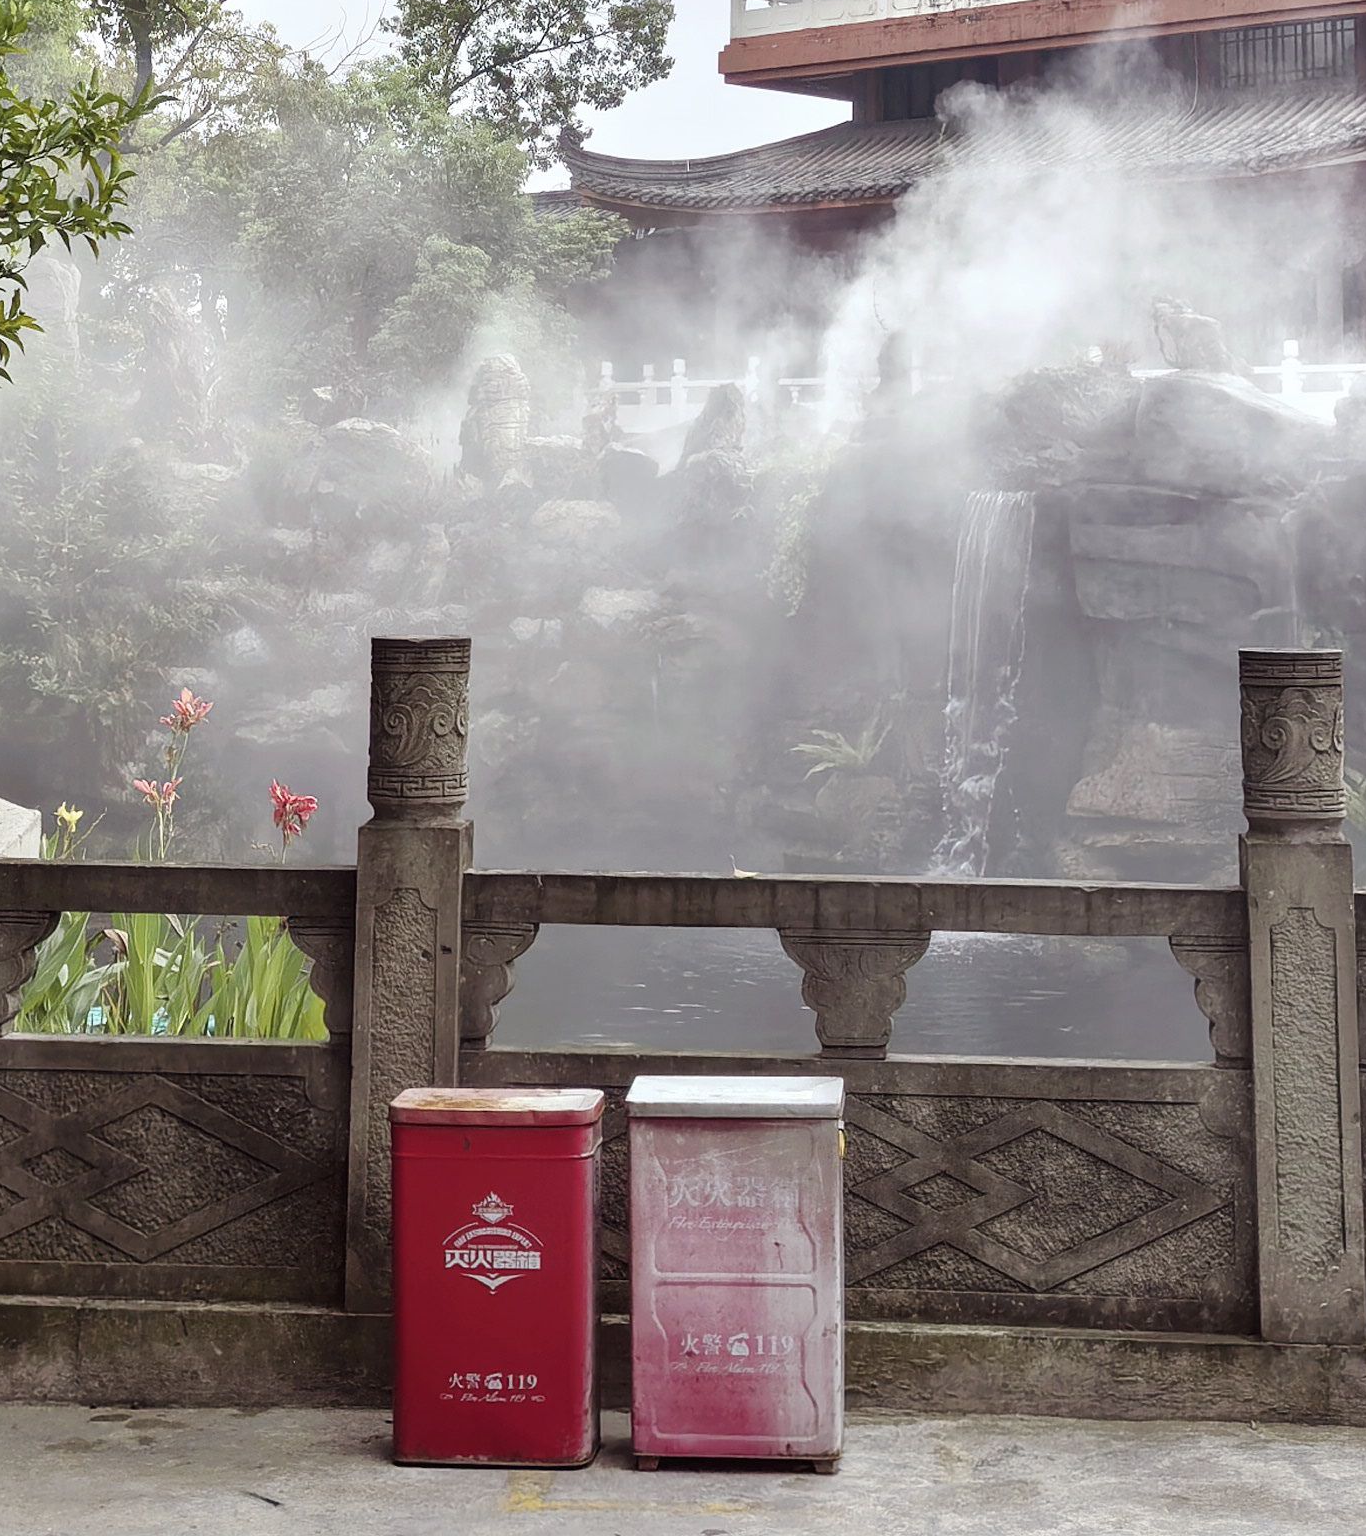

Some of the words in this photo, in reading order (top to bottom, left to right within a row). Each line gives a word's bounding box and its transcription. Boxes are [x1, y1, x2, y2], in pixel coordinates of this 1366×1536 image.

[444, 1249, 541, 1270] 灭火器箱
[679, 1333, 722, 1356] 火警
[754, 1335, 794, 1356] 119
[448, 1372, 481, 1390] 火警
[507, 1374, 538, 1390] 119
